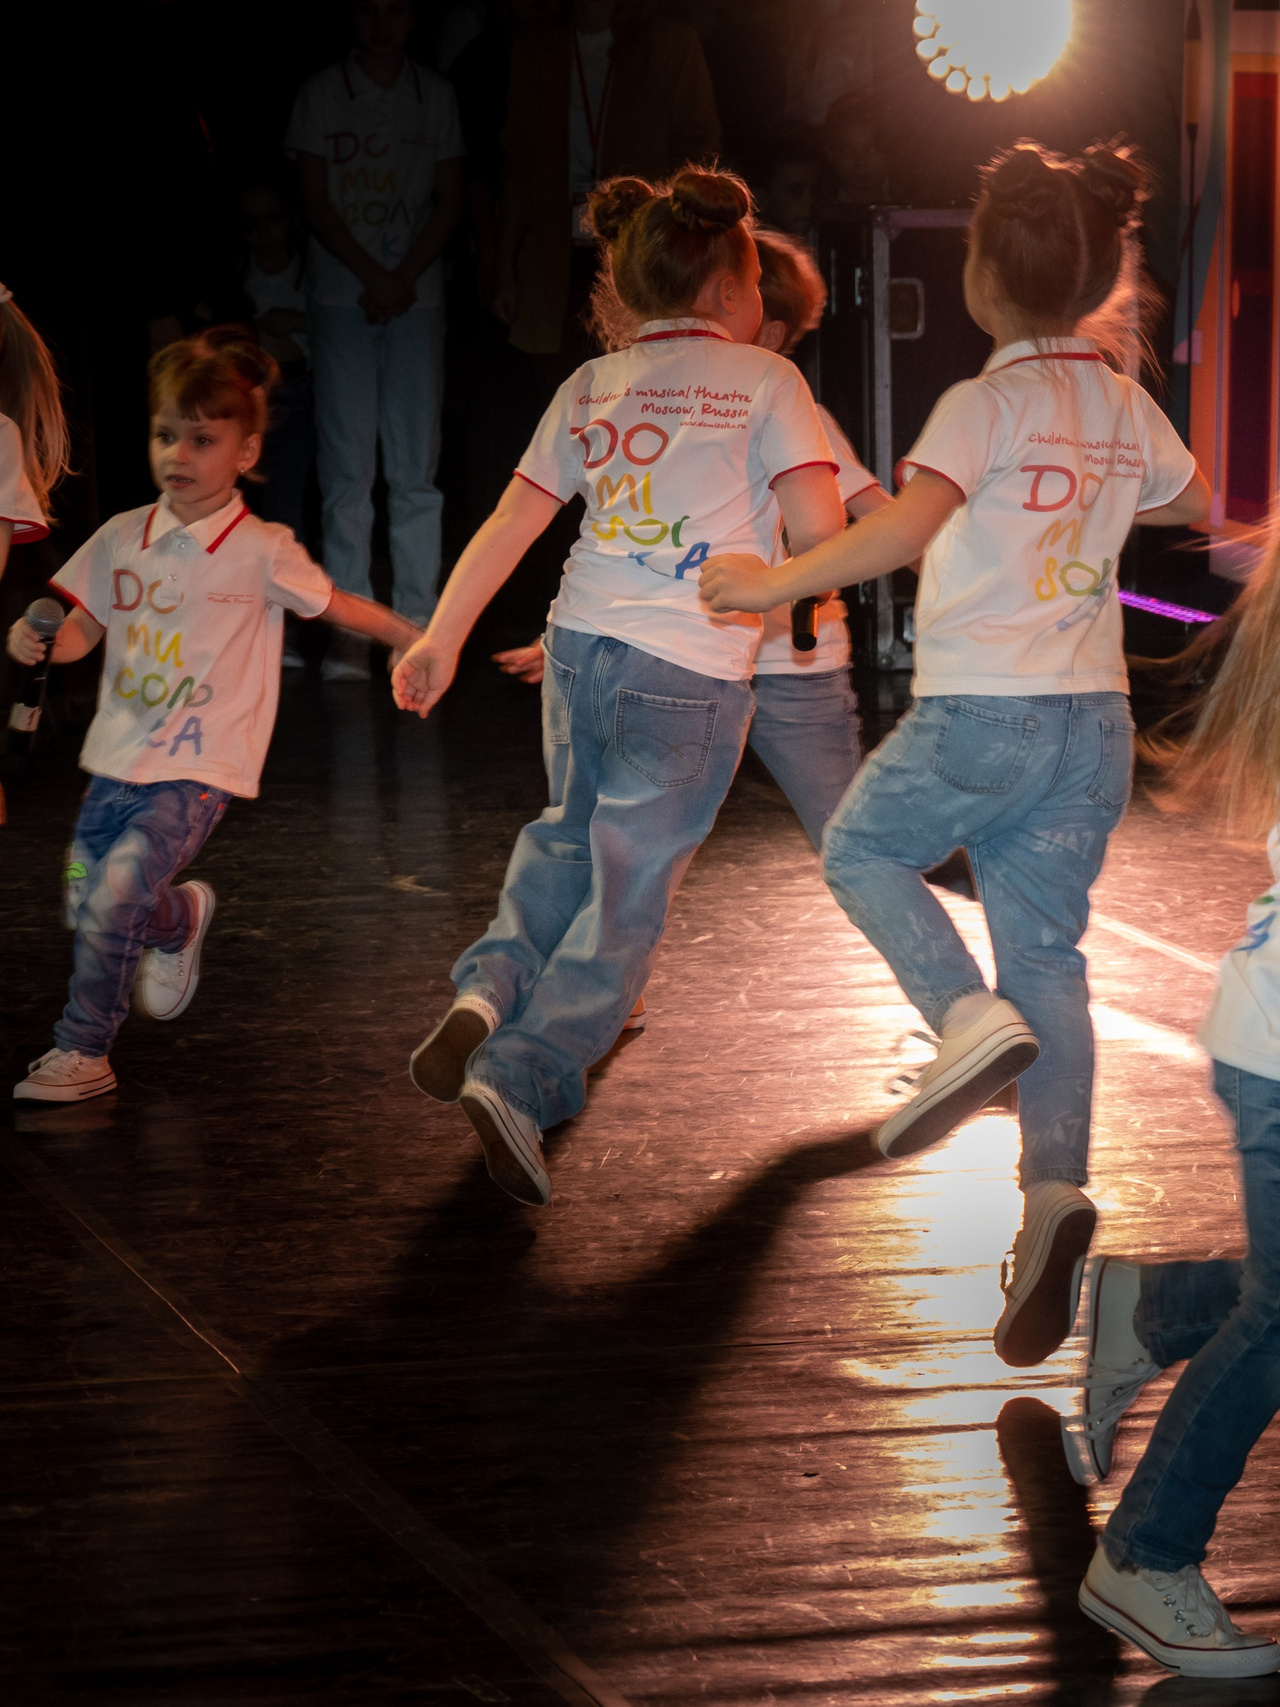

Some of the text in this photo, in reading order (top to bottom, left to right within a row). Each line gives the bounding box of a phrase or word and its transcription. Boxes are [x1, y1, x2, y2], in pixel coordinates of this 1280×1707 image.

[635, 384, 691, 400] musical
[693, 385, 753, 404] theatre
[640, 402, 749, 420] Moscow, Russia
[569, 418, 670, 469] DO
[596, 471, 654, 516] MI
[1020, 464, 1103, 513] DO
